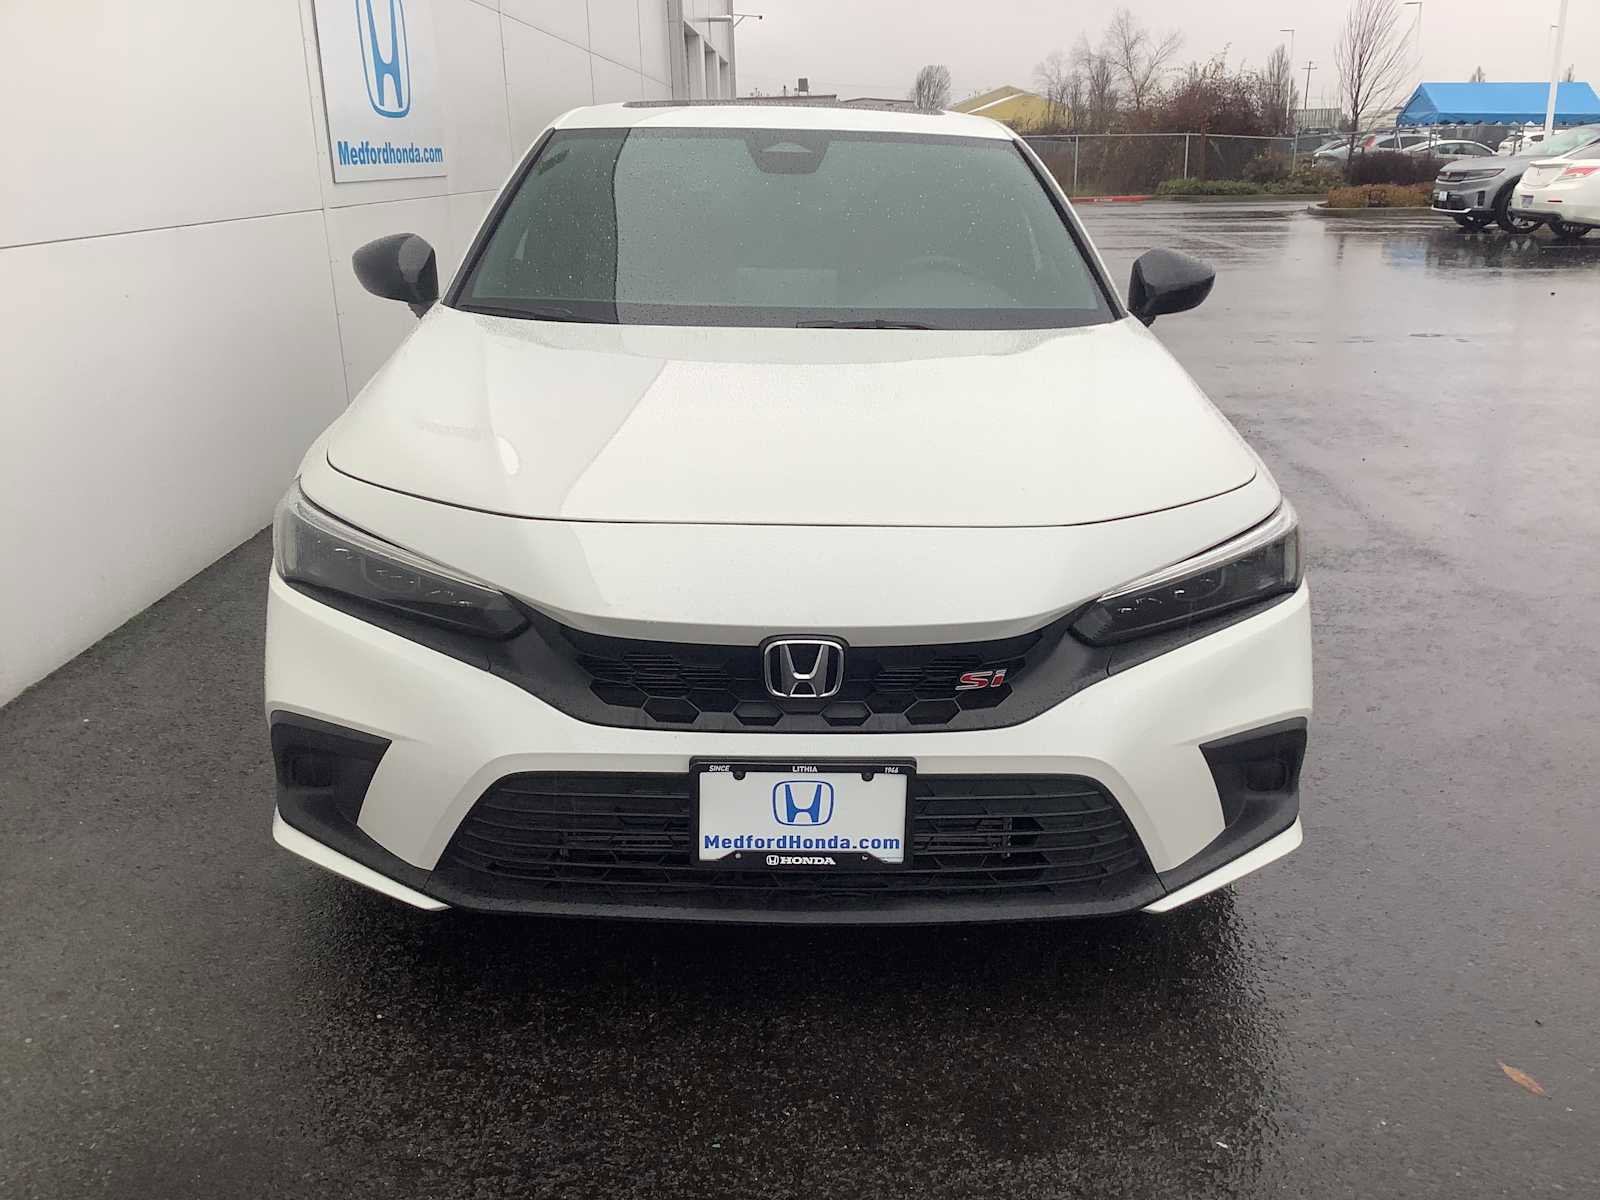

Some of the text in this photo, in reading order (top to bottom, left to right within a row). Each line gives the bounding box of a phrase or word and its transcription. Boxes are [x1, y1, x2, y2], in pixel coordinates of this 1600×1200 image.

[337, 141, 443, 165] Medfordhonda.com
[955, 668, 1007, 690] Si
[705, 835, 900, 849] MedfordHonda.com
[780, 856, 836, 865] HONDA
